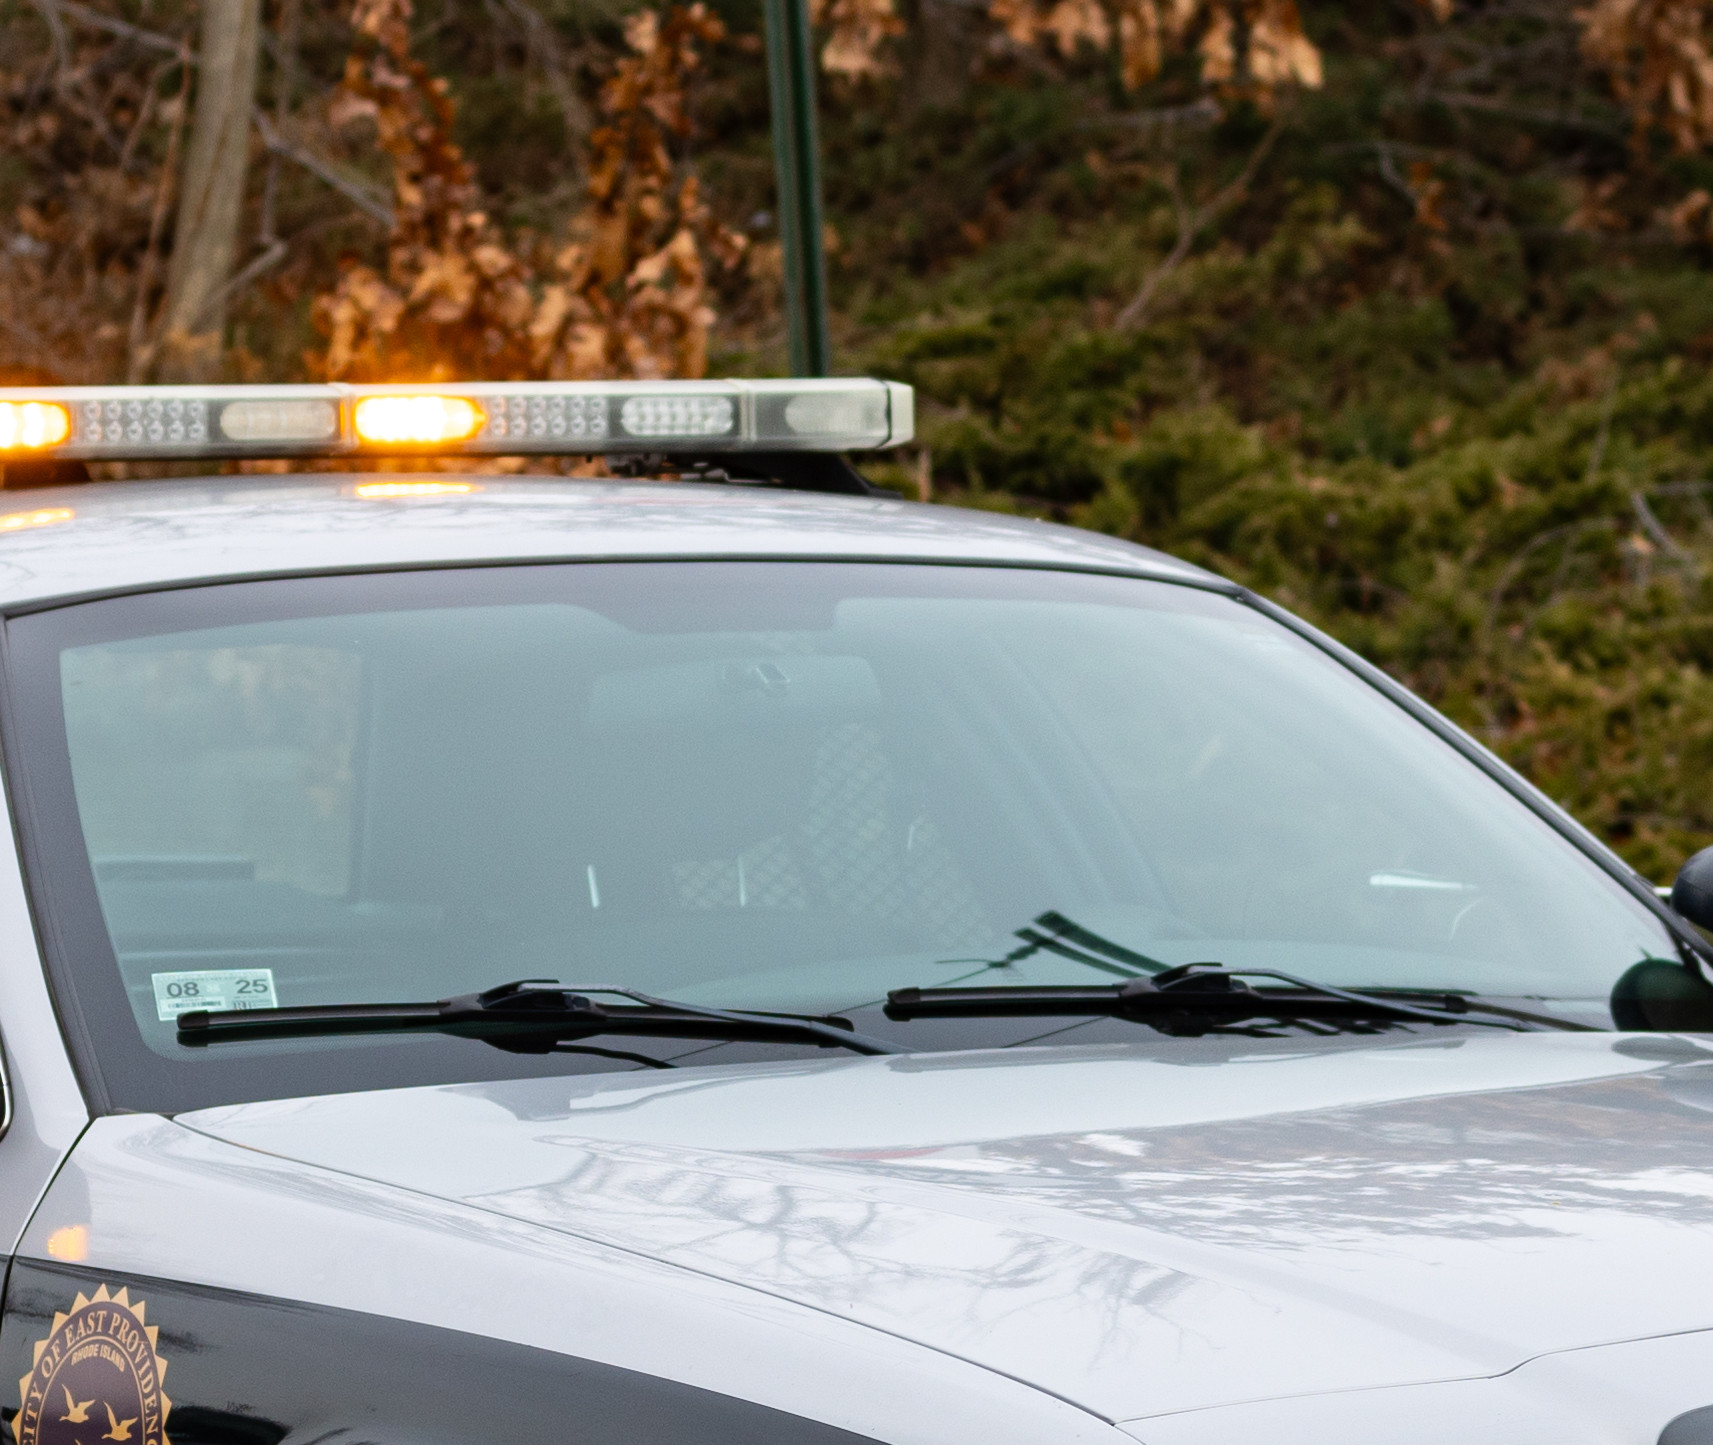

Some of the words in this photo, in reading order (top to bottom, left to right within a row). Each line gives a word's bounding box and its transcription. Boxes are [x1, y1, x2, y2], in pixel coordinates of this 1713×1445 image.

[167, 982, 200, 997] 08
[235, 979, 268, 994] 25
[41, 1339, 62, 1378] OF
[65, 1310, 107, 1349] EAST
[71, 1344, 99, 1366] RHODE
[100, 1344, 125, 1372] ISLAND
